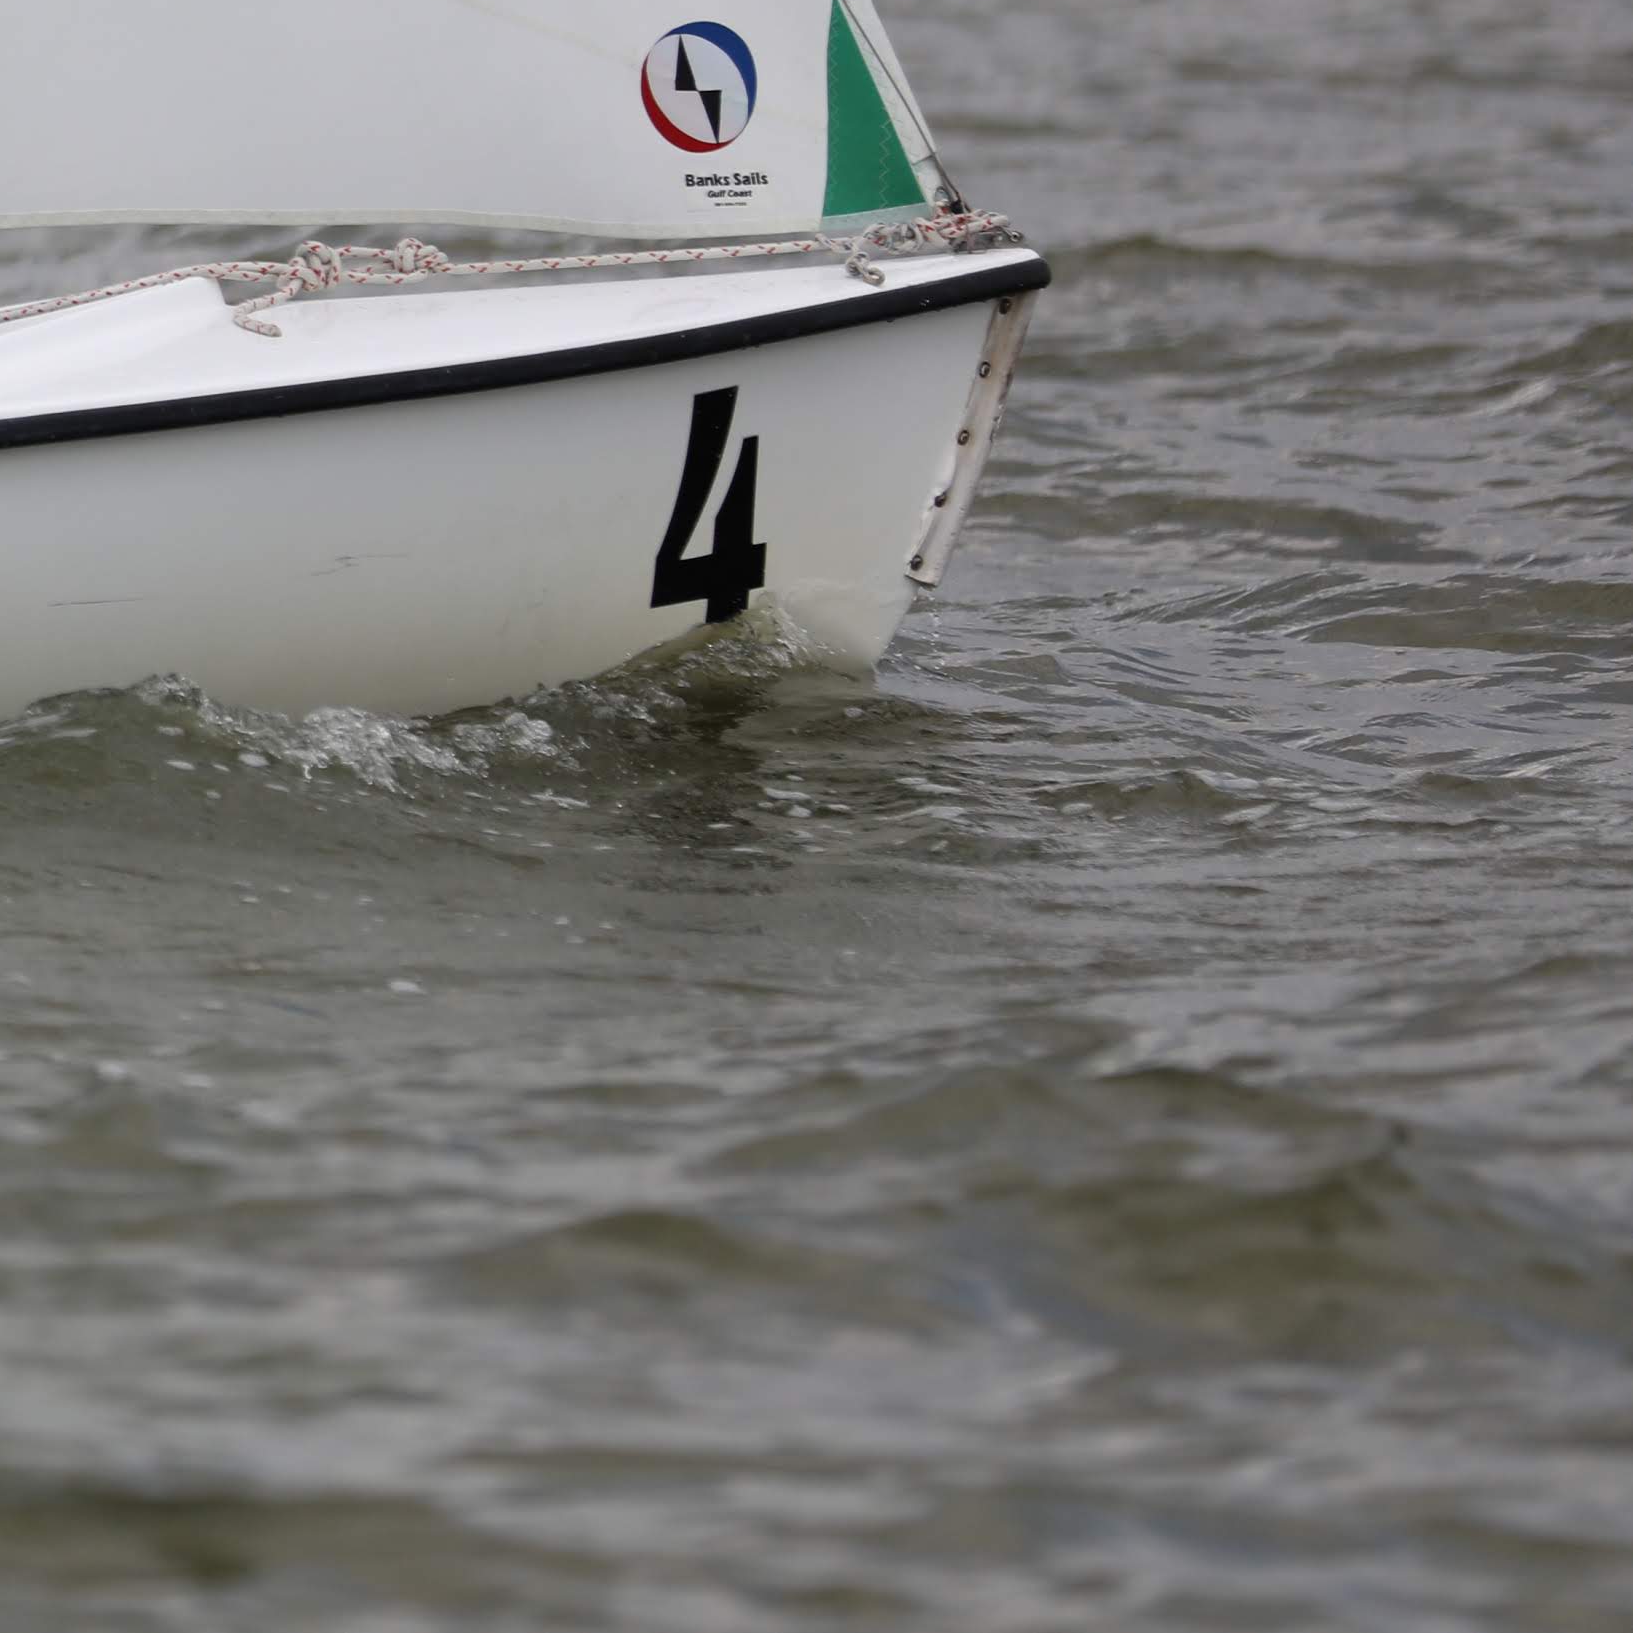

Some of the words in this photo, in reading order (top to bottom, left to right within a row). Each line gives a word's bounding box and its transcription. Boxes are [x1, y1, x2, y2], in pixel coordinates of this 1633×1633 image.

[685, 174, 730, 187] Banks
[733, 172, 769, 186] Sails
[650, 385, 767, 623] 4
